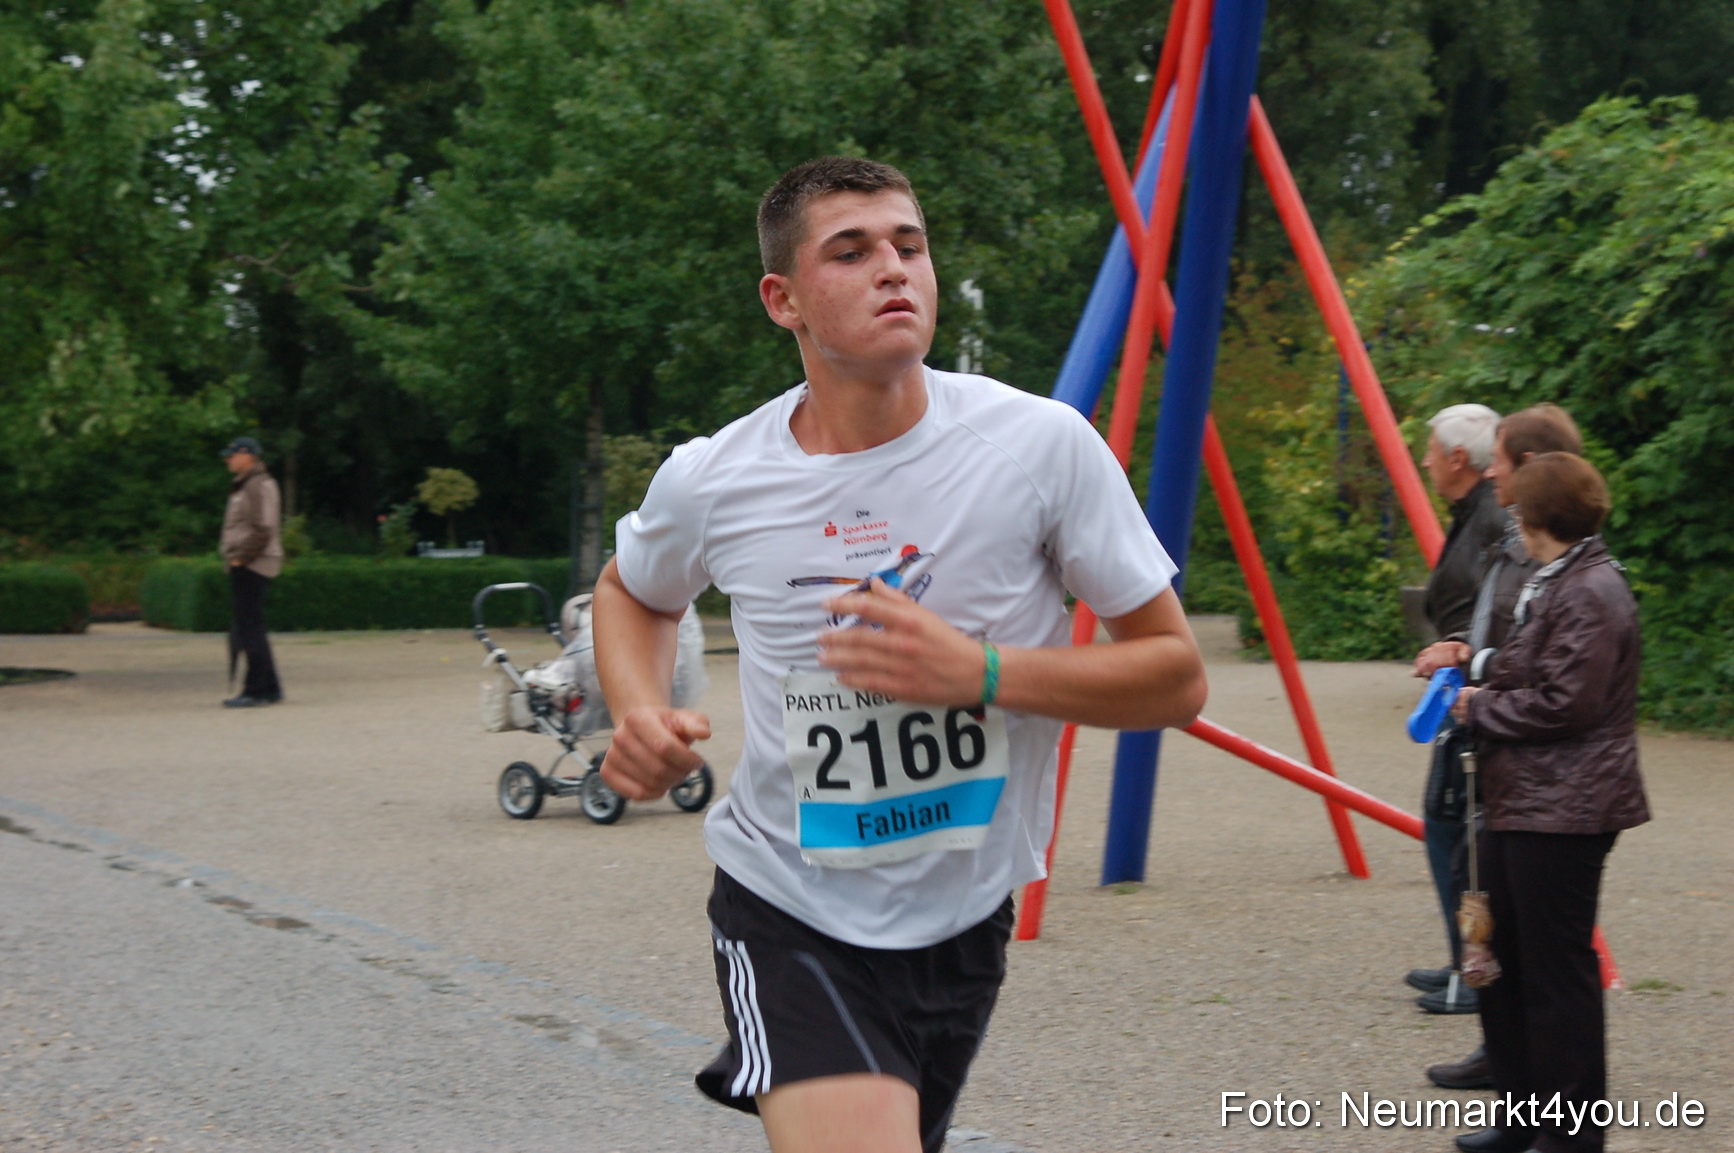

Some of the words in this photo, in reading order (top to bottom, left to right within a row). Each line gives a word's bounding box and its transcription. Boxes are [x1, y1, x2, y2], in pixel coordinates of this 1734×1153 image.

[856, 510, 869, 518] Die
[843, 521, 888, 534] Sparkasse
[844, 533, 887, 545] Nürnberg
[846, 547, 891, 561] präsentiert
[785, 694, 850, 711] PARTL
[855, 690, 896, 708] Neu
[807, 706, 986, 791] 2166
[856, 800, 951, 840] Fabian
